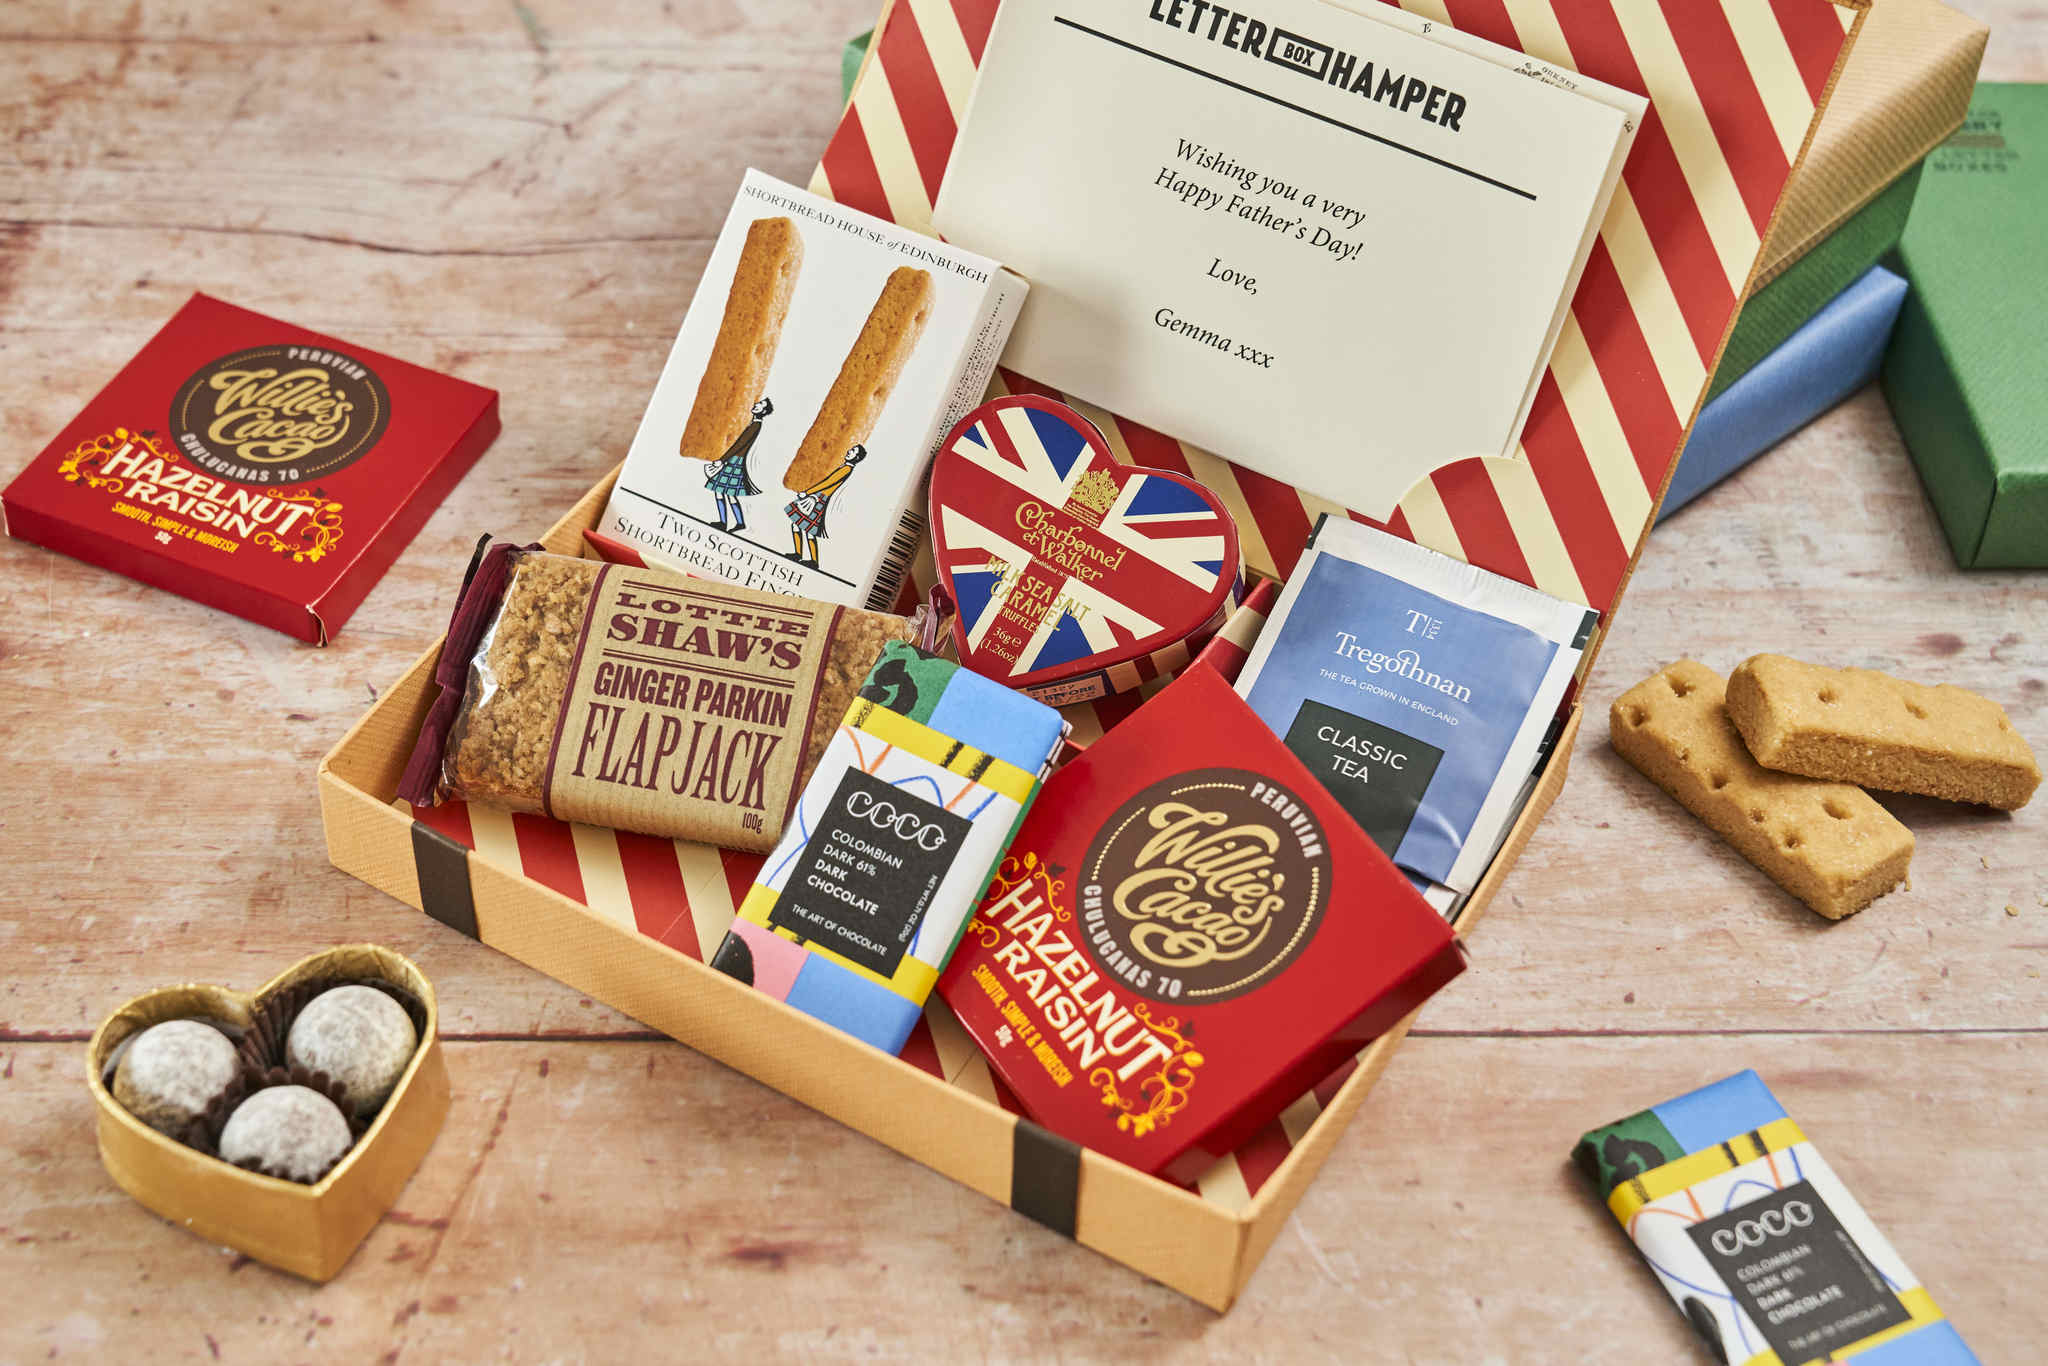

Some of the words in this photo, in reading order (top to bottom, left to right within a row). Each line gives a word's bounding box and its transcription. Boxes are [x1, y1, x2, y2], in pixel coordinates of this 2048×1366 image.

[1149, 0, 1267, 58] LETTER
[1283, 42, 1315, 67] BOX
[1328, 51, 1467, 132] HAMPER
[1154, 166, 1223, 211] Happy
[1309, 226, 1364, 261] Day!
[1176, 138, 1258, 190] Wishing
[1256, 176, 1299, 201] you
[1302, 193, 1317, 208] a
[1322, 199, 1366, 229] very
[744, 185, 835, 226] SHORTBREAD
[837, 218, 885, 246] HOUSE
[887, 239, 899, 250] of
[900, 242, 989, 285] EDINBURGH
[1207, 257, 1257, 295] Love,
[286, 346, 368, 381] PERUVIAN
[1154, 308, 1232, 352] Gemma
[1234, 344, 1275, 368] xxx
[207, 406, 336, 447] Cacao
[180, 432, 271, 483] CHULUCANAS
[278, 467, 300, 482] 70
[99, 441, 317, 536] HAZELNUT
[123, 478, 259, 540] RAISIN
[613, 516, 740, 581] SHORTBREAD
[656, 511, 702, 543] TWO
[703, 529, 804, 587] SCOTTISH
[1015, 501, 1127, 571] Charbonnel
[1038, 535, 1104, 581] Walker
[615, 592, 810, 638] LOTTIE
[984, 555, 1025, 585] MILK
[1022, 575, 1054, 603] SEA
[1053, 592, 1091, 622] SALT
[990, 581, 1064, 632] CARAMEL
[593, 661, 691, 710] GINGER
[692, 677, 793, 728] PARKIN
[1319, 668, 1337, 681] THE
[1340, 674, 1357, 687] TEA
[1359, 681, 1398, 701] GROWN
[1398, 695, 1410, 706] IN
[1411, 701, 1459, 726] ENGLAND
[1335, 631, 1472, 704] Tregothnan
[571, 701, 784, 811] FLAPJACK
[1317, 726, 1408, 770] CLASSIC
[1332, 754, 1369, 784] TEA
[741, 811, 765, 835] 100g
[831, 828, 904, 870] COLOMBIAN
[1250, 781, 1325, 859] PERUVIAN
[815, 858, 849, 882] DARK
[823, 843, 856, 867] DARK
[856, 859, 878, 877] 61%
[807, 874, 880, 917] CHOCOLATE
[1112, 867, 1251, 948] Cacao
[792, 904, 808, 919] THE
[807, 911, 825, 925] ART
[824, 919, 837, 932] OF
[837, 923, 888, 957] CHOCOLATE
[1082, 884, 1154, 989] CHULUCANAS
[1157, 974, 1184, 999] 70
[985, 878, 1173, 1082] HAZELNUT
[993, 938, 1107, 1071] RAISIN
[1001, 1000, 1037, 1040] SIMPLE
